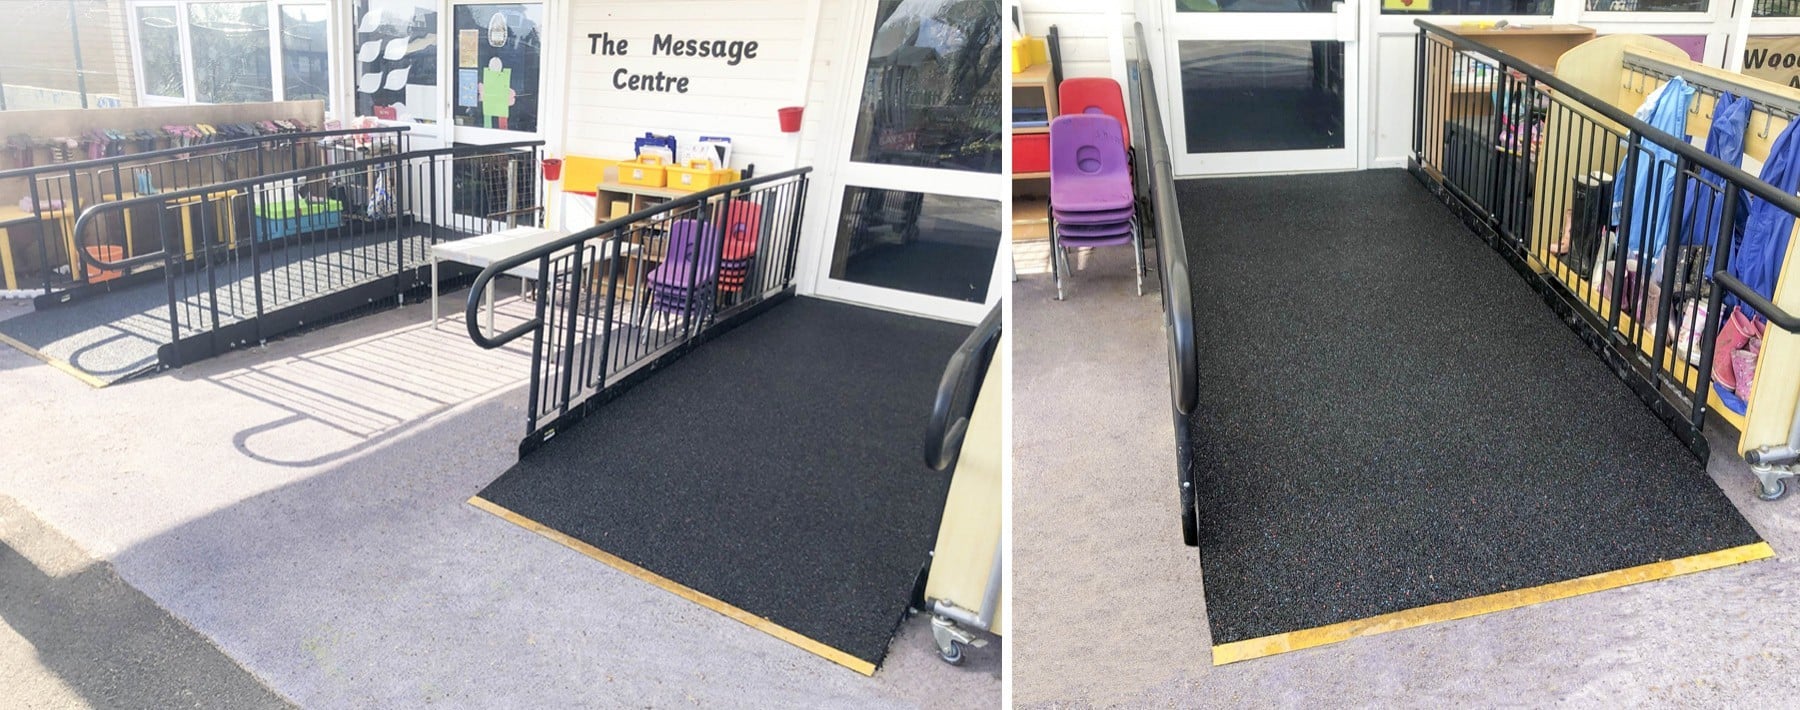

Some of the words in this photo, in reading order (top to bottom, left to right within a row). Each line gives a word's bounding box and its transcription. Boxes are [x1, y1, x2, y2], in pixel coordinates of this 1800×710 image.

[588, 32, 628, 56] The
[652, 34, 758, 66] Message
[1744, 48, 1800, 69] Woo
[613, 68, 689, 93] Centre
